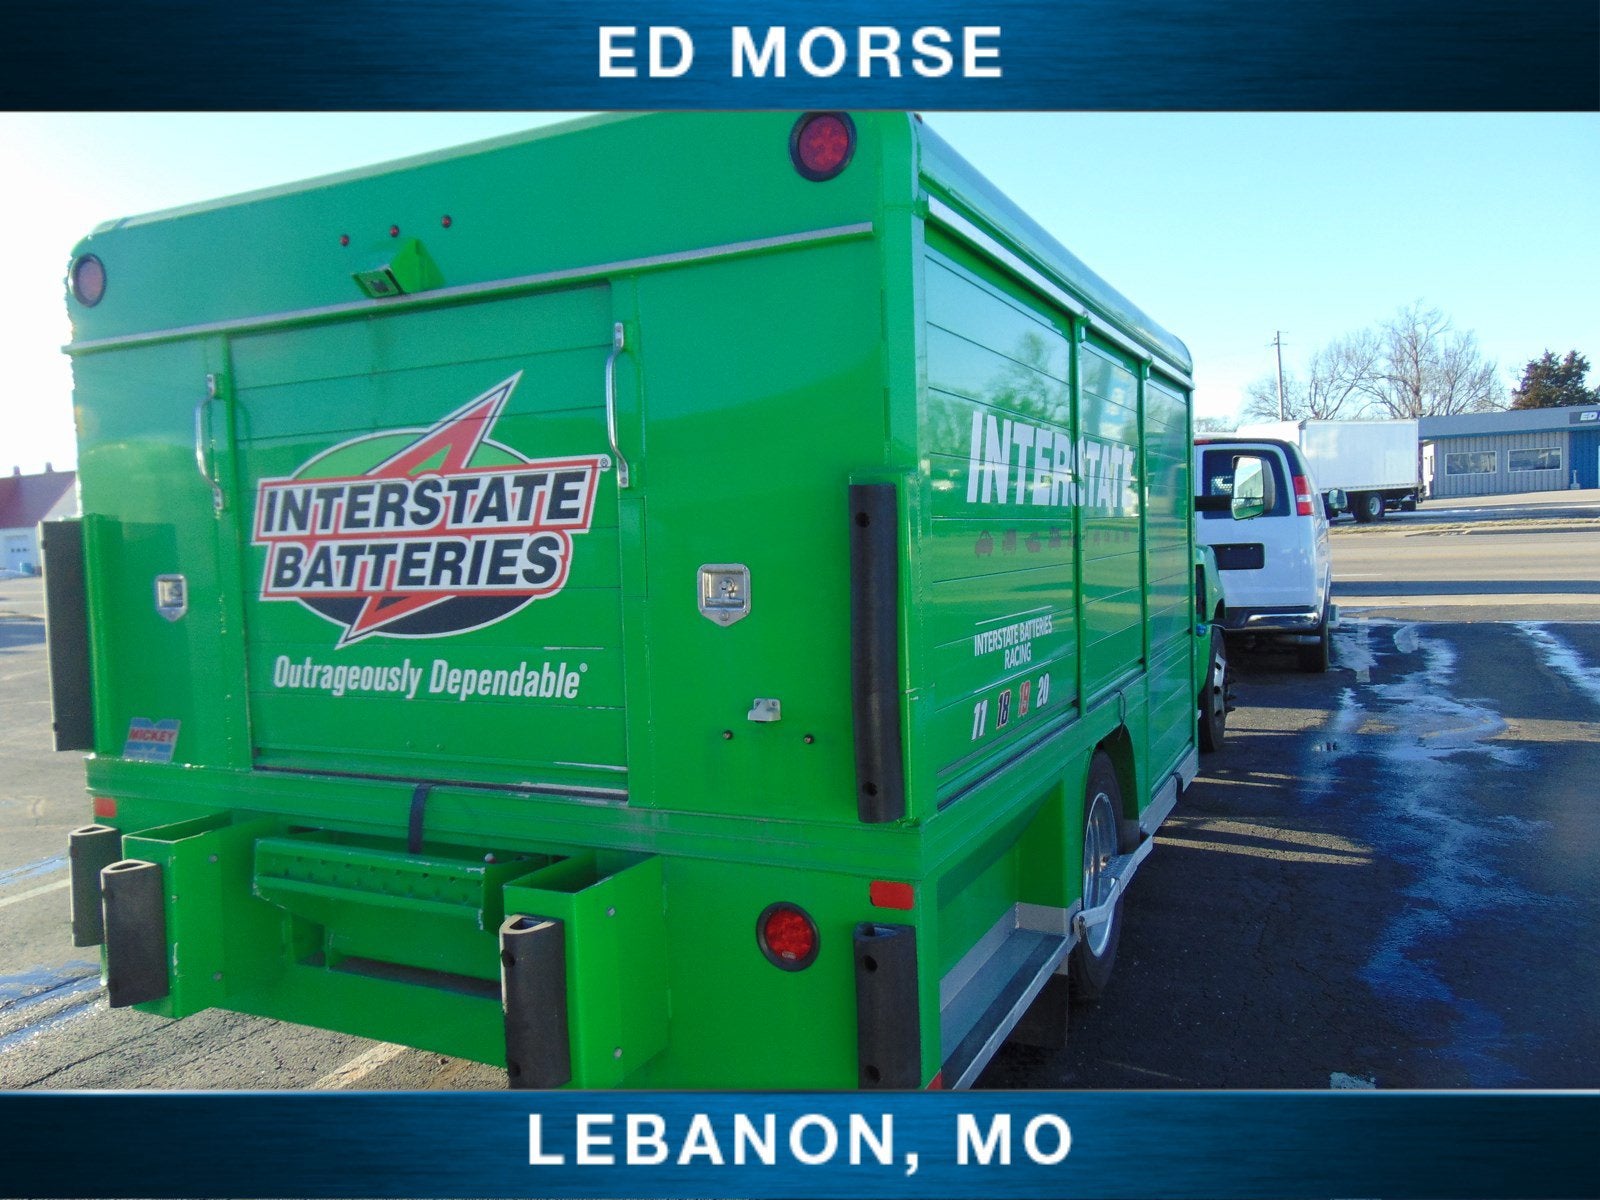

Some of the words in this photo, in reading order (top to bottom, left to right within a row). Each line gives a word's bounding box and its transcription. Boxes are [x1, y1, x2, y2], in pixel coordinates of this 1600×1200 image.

[263, 471, 588, 533] INTERSTATE
[272, 536, 560, 588] BATTERIES
[974, 624, 1019, 657] INTERSTATE
[1019, 615, 1053, 641] BATTERIES
[1004, 641, 1032, 670] RACING
[273, 655, 423, 699] Outrageously
[971, 699, 988, 741] 11
[996, 689, 1012, 730] 18
[1018, 679, 1031, 718] 19
[1036, 672, 1050, 709] 20
